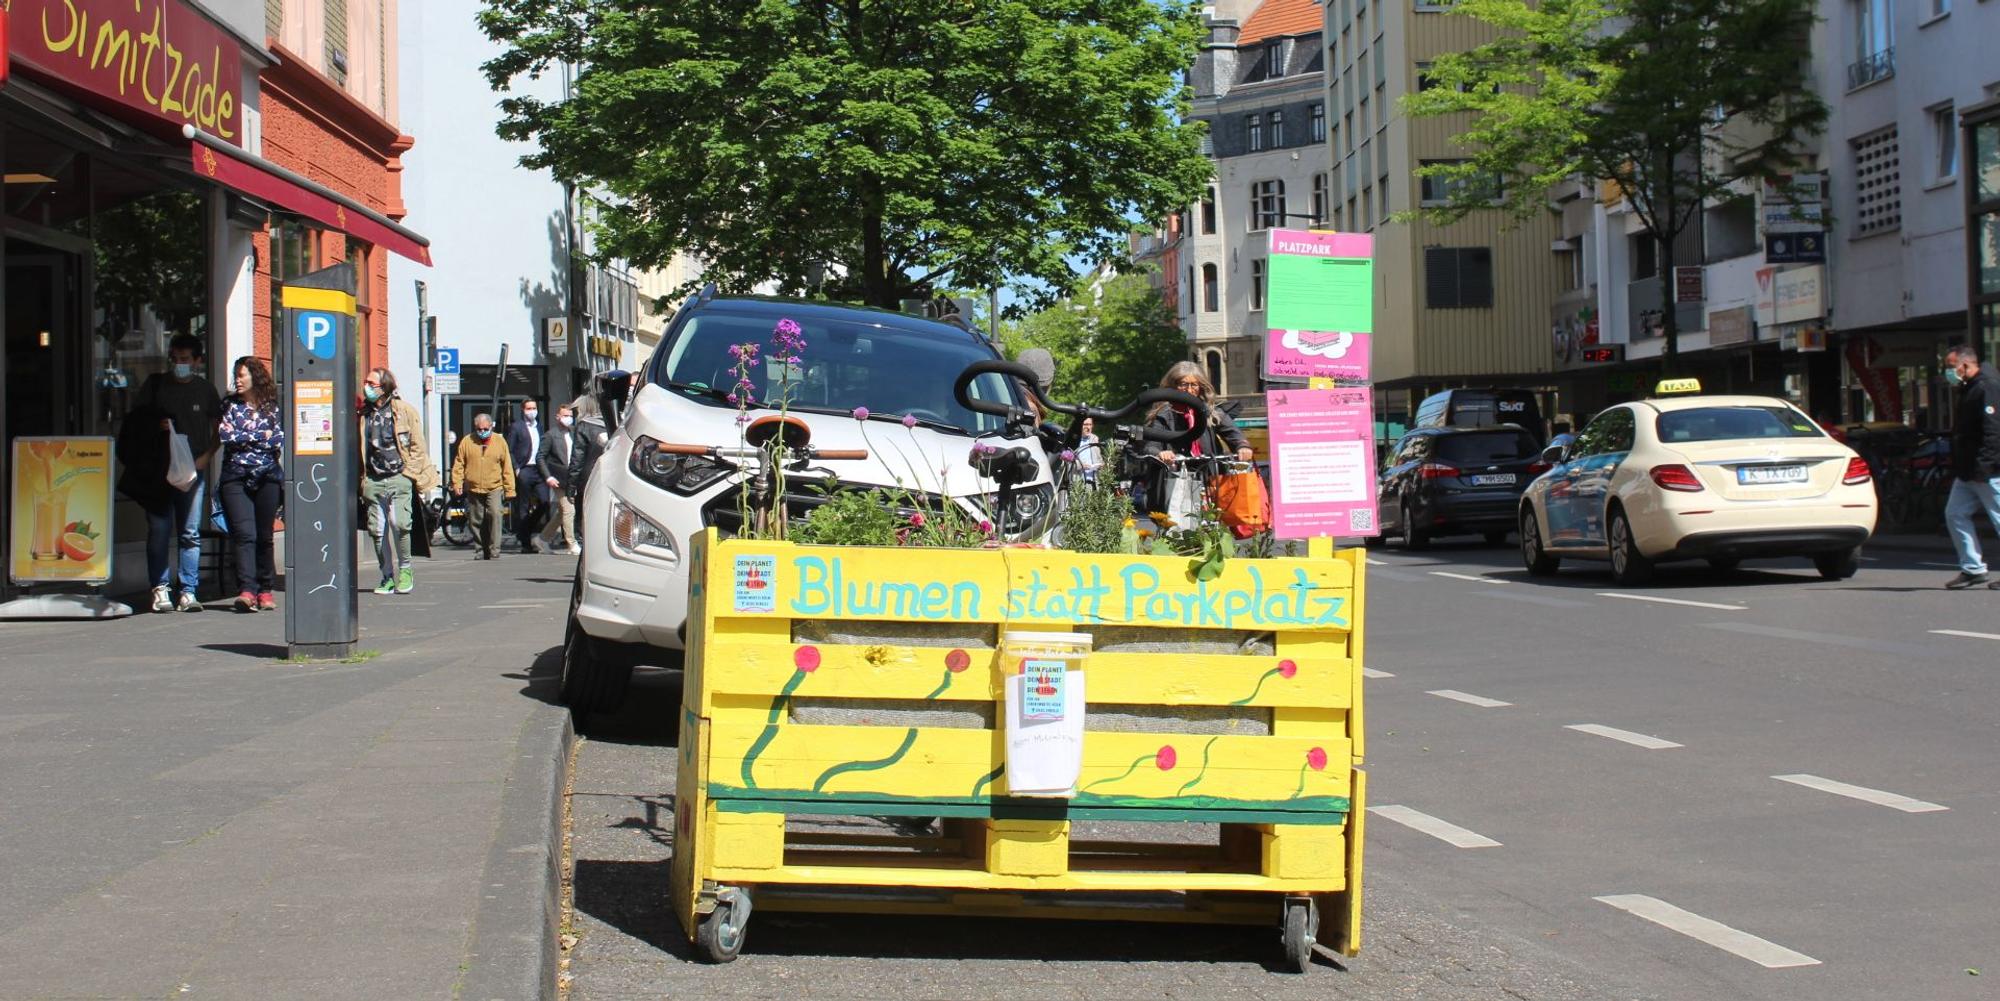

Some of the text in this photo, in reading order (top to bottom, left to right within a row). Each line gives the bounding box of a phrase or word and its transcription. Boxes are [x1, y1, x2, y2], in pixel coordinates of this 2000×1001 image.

[1279, 241, 1331, 255] PLATZPARK
[307, 316, 331, 351] P
[437, 351, 452, 372] P
[1664, 382, 1697, 391] TAXI
[791, 556, 1347, 628] Blumen statt Parkplatz
